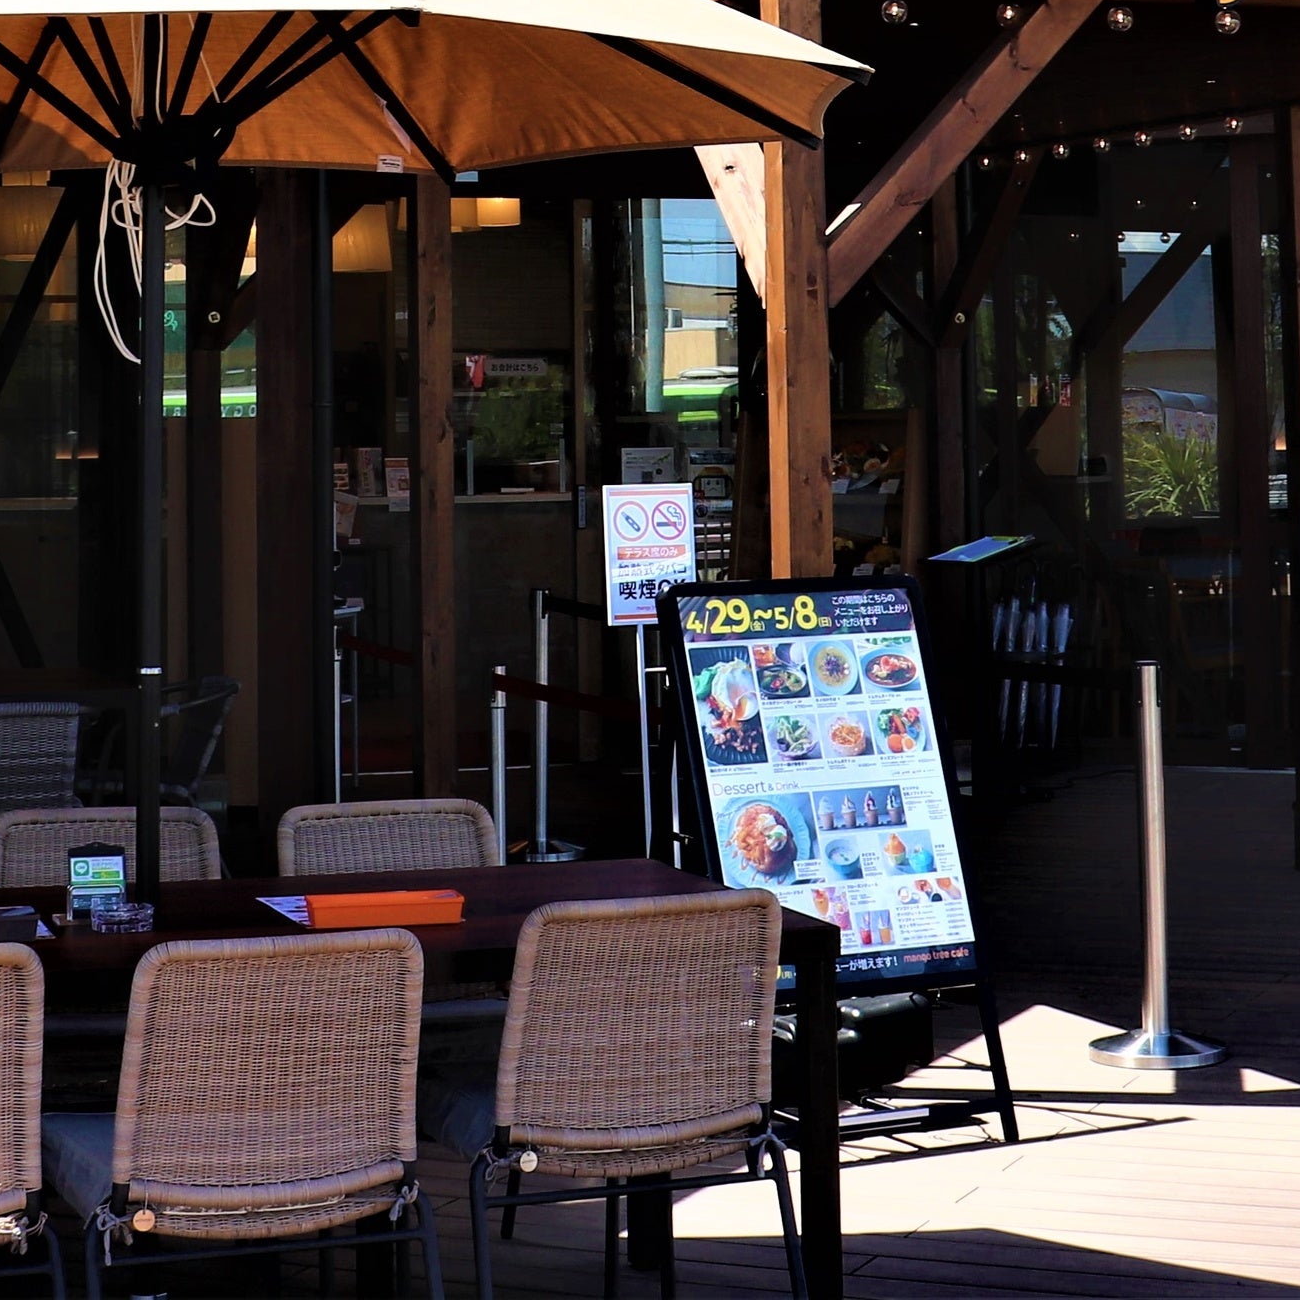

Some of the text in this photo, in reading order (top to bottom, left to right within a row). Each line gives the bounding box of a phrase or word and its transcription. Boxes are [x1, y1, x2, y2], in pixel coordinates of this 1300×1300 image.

[712, 781, 767, 796] Dessert
[775, 780, 800, 791] Drink
[903, 946, 969, 964] mango tree cafe
